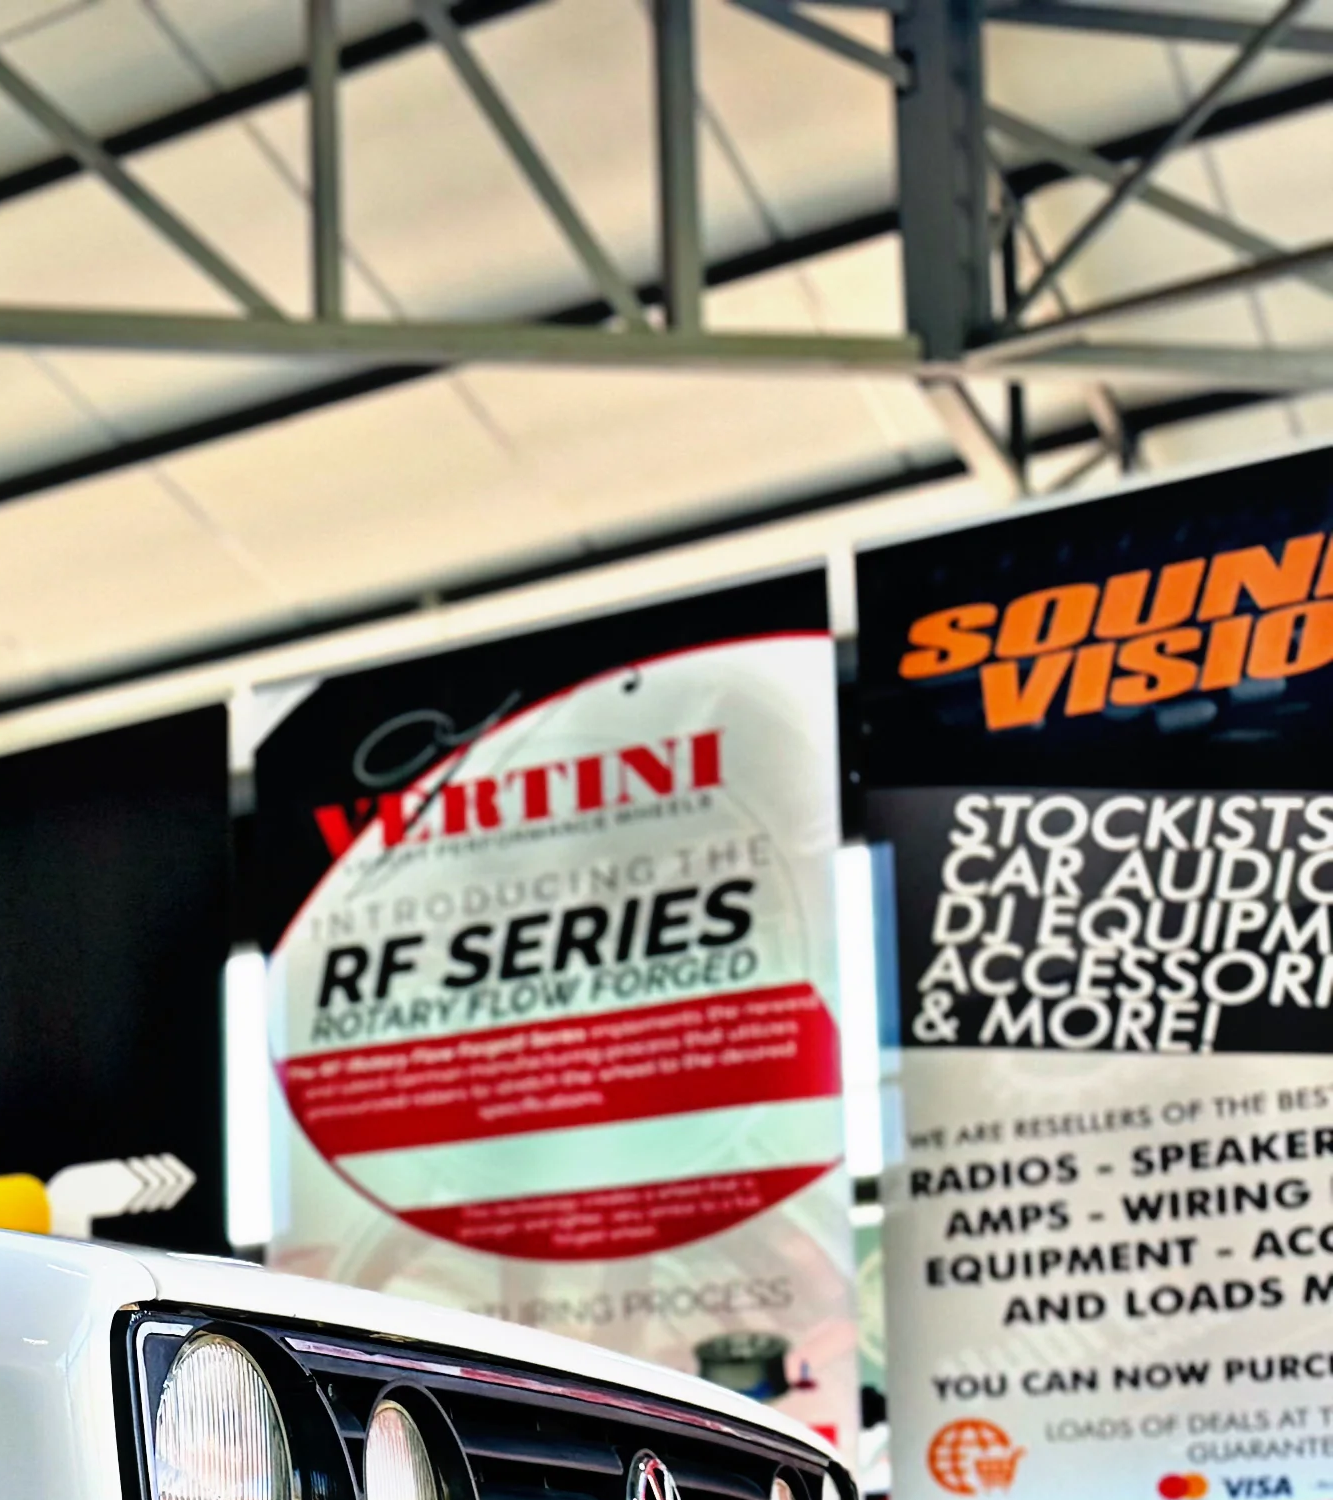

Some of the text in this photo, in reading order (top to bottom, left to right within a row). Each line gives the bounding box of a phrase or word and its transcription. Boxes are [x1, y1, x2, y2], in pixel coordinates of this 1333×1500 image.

[899, 532, 1333, 680] SOUN
[313, 728, 725, 859] VERTINI
[949, 795, 1333, 852] STOCKISTS
[311, 856, 655, 941] INTRODUCING
[673, 834, 776, 880] THE
[941, 843, 1084, 898] CAR
[318, 878, 758, 1008] RF SERIES
[932, 892, 1333, 955] DJ EQUIPM
[310, 948, 758, 1044] ROTARY FLOW FORGED
[912, 992, 1222, 1049] & MORE!
[955, 1120, 1002, 1145] ARE
[1014, 1104, 1153, 1139] RESELLERS
[1161, 1098, 1203, 1127] OF
[1214, 1088, 1267, 1118] THE
[1277, 1083, 1333, 1112] BES
[909, 1152, 1079, 1199] RADIOS
[945, 1200, 1071, 1241] AMPS
[1123, 1178, 1311, 1227] WIRING
[926, 1236, 1199, 1287] EQUIPMENT
[621, 1276, 794, 1323] PROCESS
[1003, 1289, 1105, 1326] AND
[1126, 1277, 1284, 1319] LOADS
[931, 1352, 1333, 1401] YOU CAN NOW PURC
[1045, 1416, 1133, 1443] LOADS
[1139, 1414, 1177, 1438] OF
[1186, 1409, 1270, 1436] DEALS
[1277, 1407, 1307, 1430] AT
[1223, 1475, 1294, 1500] VISA
